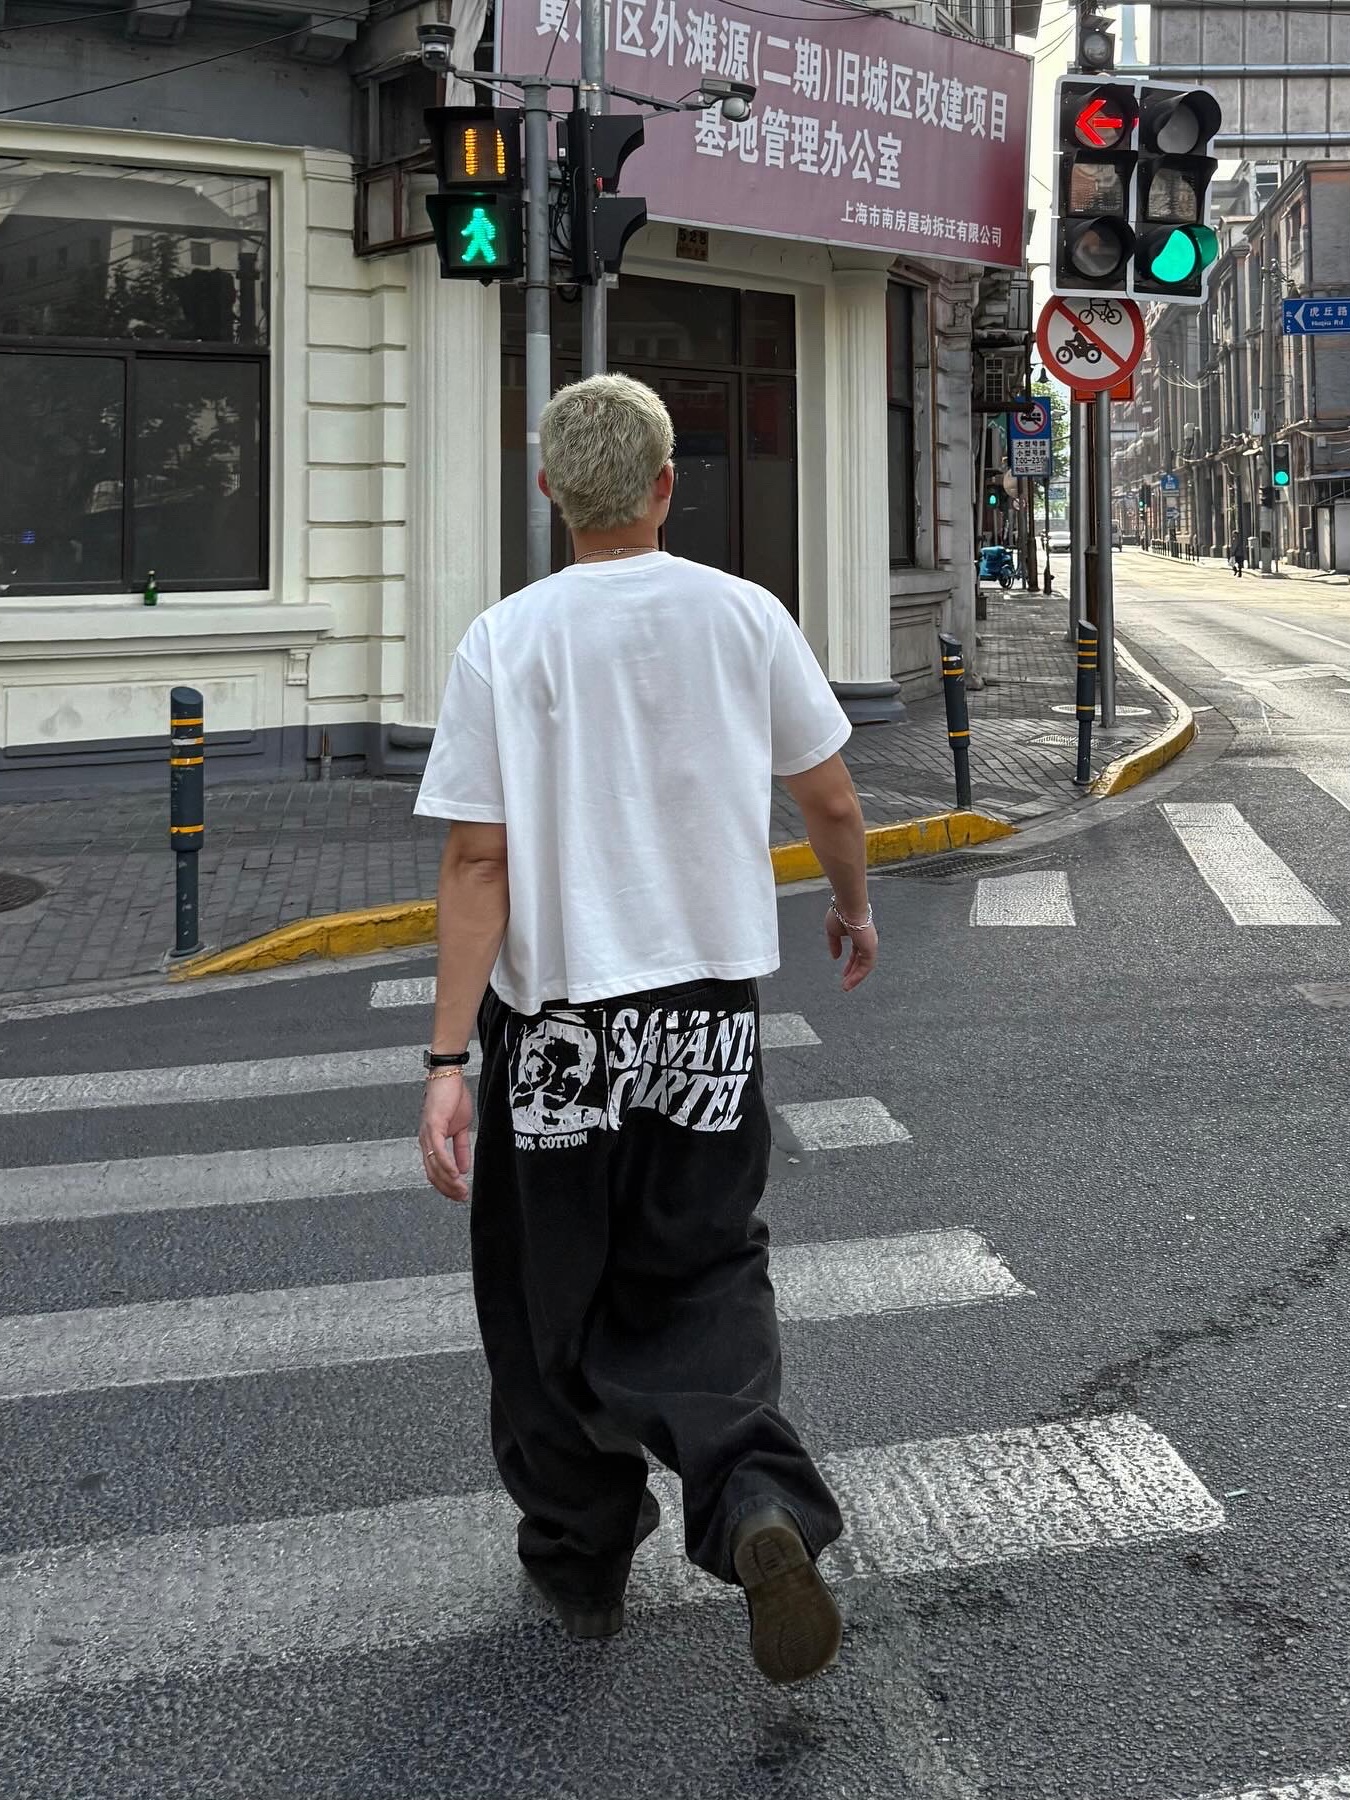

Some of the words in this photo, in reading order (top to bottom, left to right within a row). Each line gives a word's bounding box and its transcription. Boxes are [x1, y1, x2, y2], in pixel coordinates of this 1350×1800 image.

[534, 0, 1008, 143] 黄区外滩源(二期)旧城区改建项目
[694, 96, 902, 190] 基地管理办公室
[841, 200, 1002, 248] 上海市南房屋动拆迁有限公司
[539, 1131, 588, 1149] COTTON
